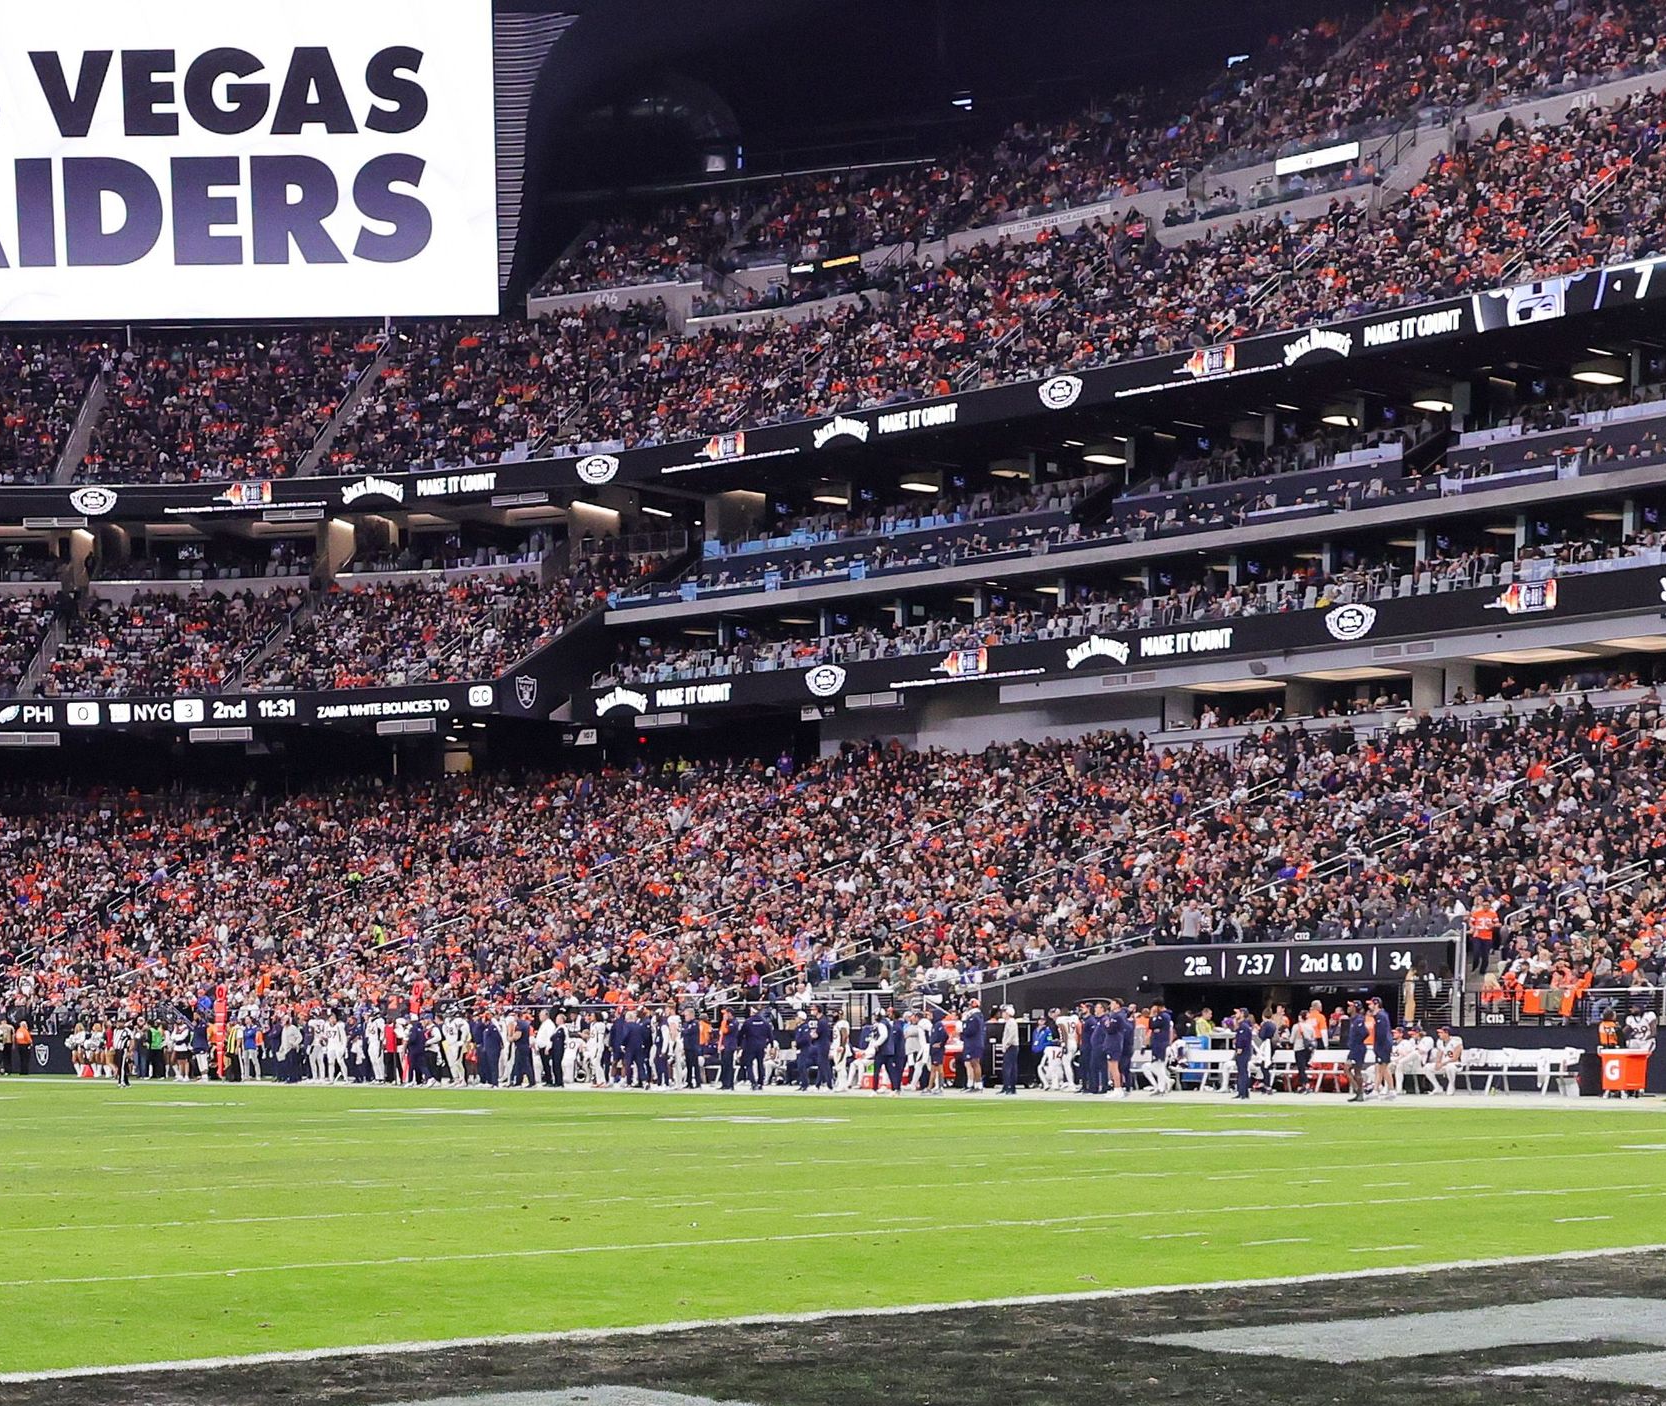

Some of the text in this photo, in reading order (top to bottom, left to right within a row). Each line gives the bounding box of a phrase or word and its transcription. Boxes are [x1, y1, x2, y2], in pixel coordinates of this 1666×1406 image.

[29, 45, 428, 137] VEGAS
[1634, 264, 1655, 299] 7
[1284, 337, 1312, 367] JACK
[1364, 322, 1402, 348] MAKE
[1402, 319, 1417, 340] IT
[1415, 308, 1463, 336] COUNT
[878, 415, 908, 434] MAKE
[909, 412, 921, 430] IT
[416, 477, 446, 497] MAKE
[448, 476, 460, 494] IT
[1140, 634, 1175, 658] MAKE
[1176, 631, 1191, 655] IT
[1190, 627, 1233, 653] COUNT
[471, 688, 489, 704] CC
[656, 686, 683, 708] MAKE
[683, 684, 696, 706] IT
[23, 706, 89, 724] PHI 0
[134, 703, 194, 722] NYG 3
[213, 699, 296, 719] 2nd 11:31
[349, 702, 382, 717] WHITE
[383, 700, 433, 715] BOUNCES
[434, 698, 450, 712] TO
[1294, 931, 1310, 941] C112
[1184, 956, 1195, 976] 2
[1195, 956, 1207, 966] ND
[1196, 965, 1212, 976] QTR
[1236, 951, 1412, 975] 7:37 2nd & 10 34
[1486, 1014, 1504, 1024] C113
[1605, 1065, 1620, 1082] G
